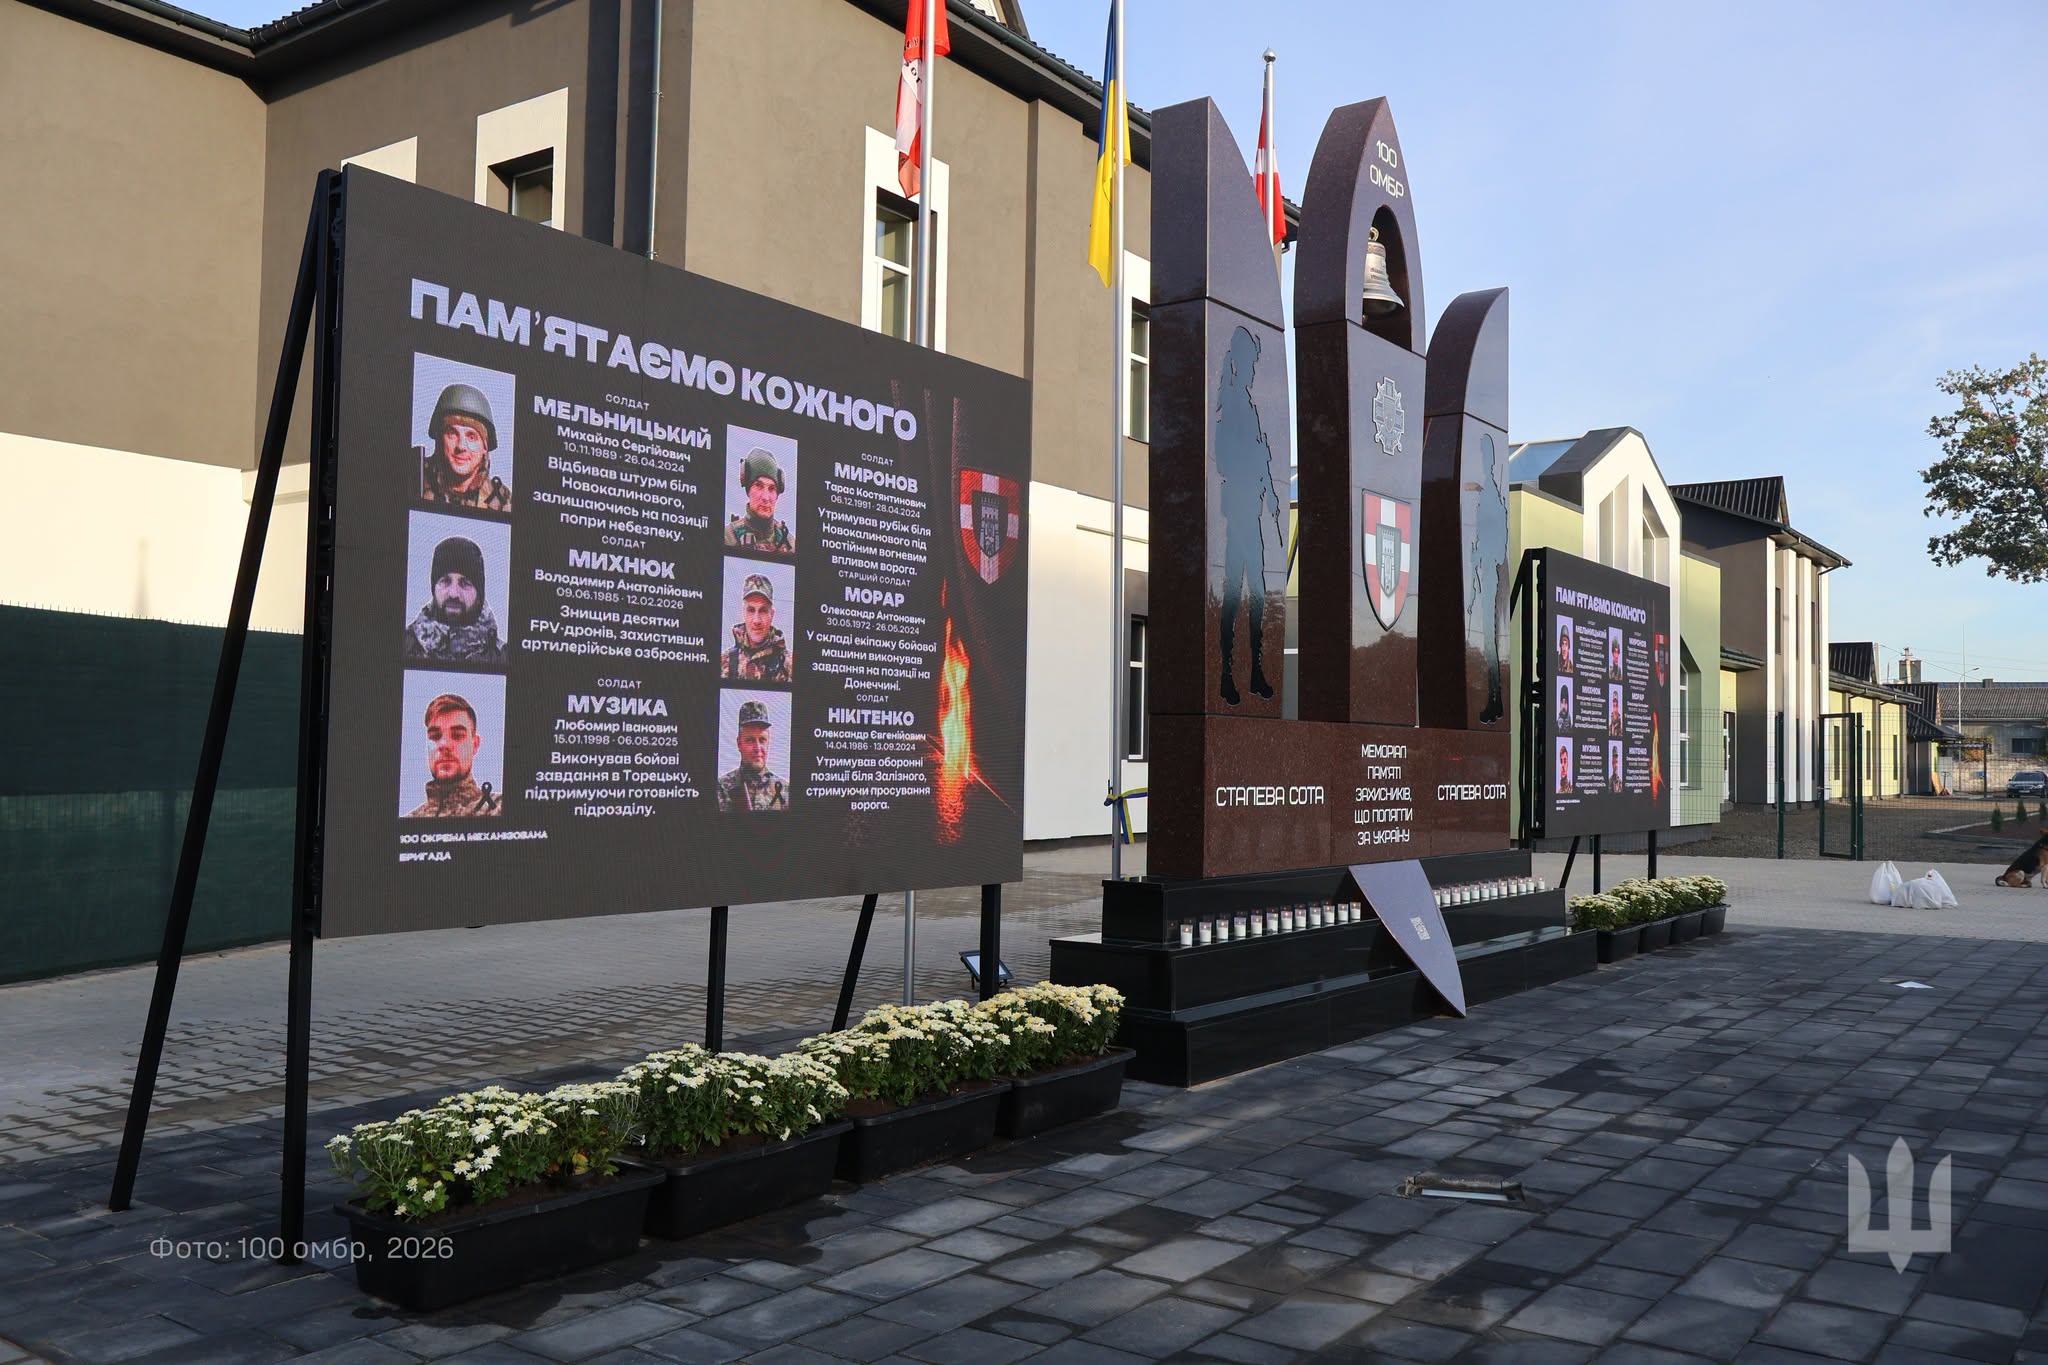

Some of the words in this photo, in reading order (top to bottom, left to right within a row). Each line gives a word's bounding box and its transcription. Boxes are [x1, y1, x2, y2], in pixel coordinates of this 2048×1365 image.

[1376, 140, 1397, 168] 100
[1370, 164, 1404, 198] ОМБР
[606, 394, 650, 410] СОЛДАТ
[741, 367, 917, 441] КОЖНОГО
[534, 395, 711, 450] МЕЛЬНИЦЬКИЙ
[557, 425, 620, 448] Михайло
[622, 439, 690, 462] Сергійович
[624, 453, 685, 473] 26.04.2024
[862, 453, 894, 466] СОЛДАТ
[548, 456, 617, 480] Відбивав
[620, 470, 667, 490] штурм
[670, 479, 697, 495] біля
[834, 462, 918, 493] МИРОНОВ
[562, 476, 685, 509] Новокалинового,
[824, 480, 854, 496] Тарас
[856, 487, 926, 509] Костянтинович
[533, 490, 638, 516] залишаючись
[642, 510, 658, 520] на
[662, 512, 708, 528] позиції
[560, 513, 606, 529] попри
[609, 520, 684, 541] небезпеку.
[818, 507, 877, 526] Утримував
[880, 520, 909, 533] рубіж
[911, 524, 931, 537] біля
[602, 535, 646, 549] СОЛДАТ
[822, 523, 910, 547] Новокалинового
[912, 538, 927, 550] під
[822, 539, 877, 555] постійним
[879, 548, 926, 563] вогневим
[569, 549, 675, 579] МИХНЮК
[832, 555, 878, 570] впливом
[880, 562, 918, 576] ворога.
[535, 569, 614, 590] Володимир
[617, 579, 703, 599] Анатолійович
[838, 570, 878, 582] СТАРШИЙ
[880, 576, 910, 587] СОЛДАТ
[845, 586, 904, 607] МОРАР
[560, 605, 620, 622] Знищив
[623, 614, 680, 628] десятки
[820, 604, 875, 620] Олександр
[876, 610, 926, 624] Антонович
[1611, 602, 1646, 624] КОЖНОГО
[620, 629, 704, 646] захистивши
[807, 630, 814, 641] У
[816, 633, 852, 645] складі
[854, 636, 896, 650] екіпажу
[898, 640, 937, 652] бойової
[522, 639, 631, 657] артилерійське
[635, 648, 710, 663] озброєння.
[822, 649, 867, 660] машини
[869, 654, 922, 665] виконував
[812, 662, 864, 674] завдання
[867, 667, 879, 675] на
[882, 667, 917, 679] позиції
[918, 671, 930, 679] на
[597, 678, 642, 689] СОЛДАТ
[844, 678, 901, 691] Донеччині.
[568, 695, 668, 716] МУЗИКА
[856, 694, 889, 703] СОЛДАТ
[828, 708, 915, 726] НІКІТЕНКО
[555, 719, 620, 733] Любомир
[623, 722, 678, 734] Іванович
[814, 728, 868, 740] Олександр
[870, 730, 926, 741] Євгенійович
[551, 752, 631, 766] Виконував
[634, 752, 679, 765] бойові
[816, 756, 876, 768] Утримував
[878, 757, 923, 768] оборонні
[536, 770, 608, 783] завдання
[612, 771, 620, 781] в
[623, 769, 691, 783] Торецьку,
[811, 772, 850, 782] позиції
[852, 771, 873, 781] біля
[875, 771, 927, 782] Залізного,
[525, 786, 625, 801] підтримуючи
[628, 786, 699, 798] готовність
[806, 787, 869, 798] стримуючи
[871, 786, 930, 797] просування
[1290, 786, 1324, 805] СОТА
[1356, 787, 1412, 802] ЗАХИСНИКІВ,
[1484, 785, 1506, 799] СОТА
[575, 803, 655, 817] підрозділу.
[851, 802, 890, 811] ворога.
[1355, 810, 1369, 825] ЩО
[400, 835, 419, 843] 100
[421, 833, 466, 843] ОКРЕМА
[1358, 831, 1370, 845] ЗА
[1373, 827, 1409, 844] УКРАЇНУ
[399, 851, 451, 862] БРИГАДА
